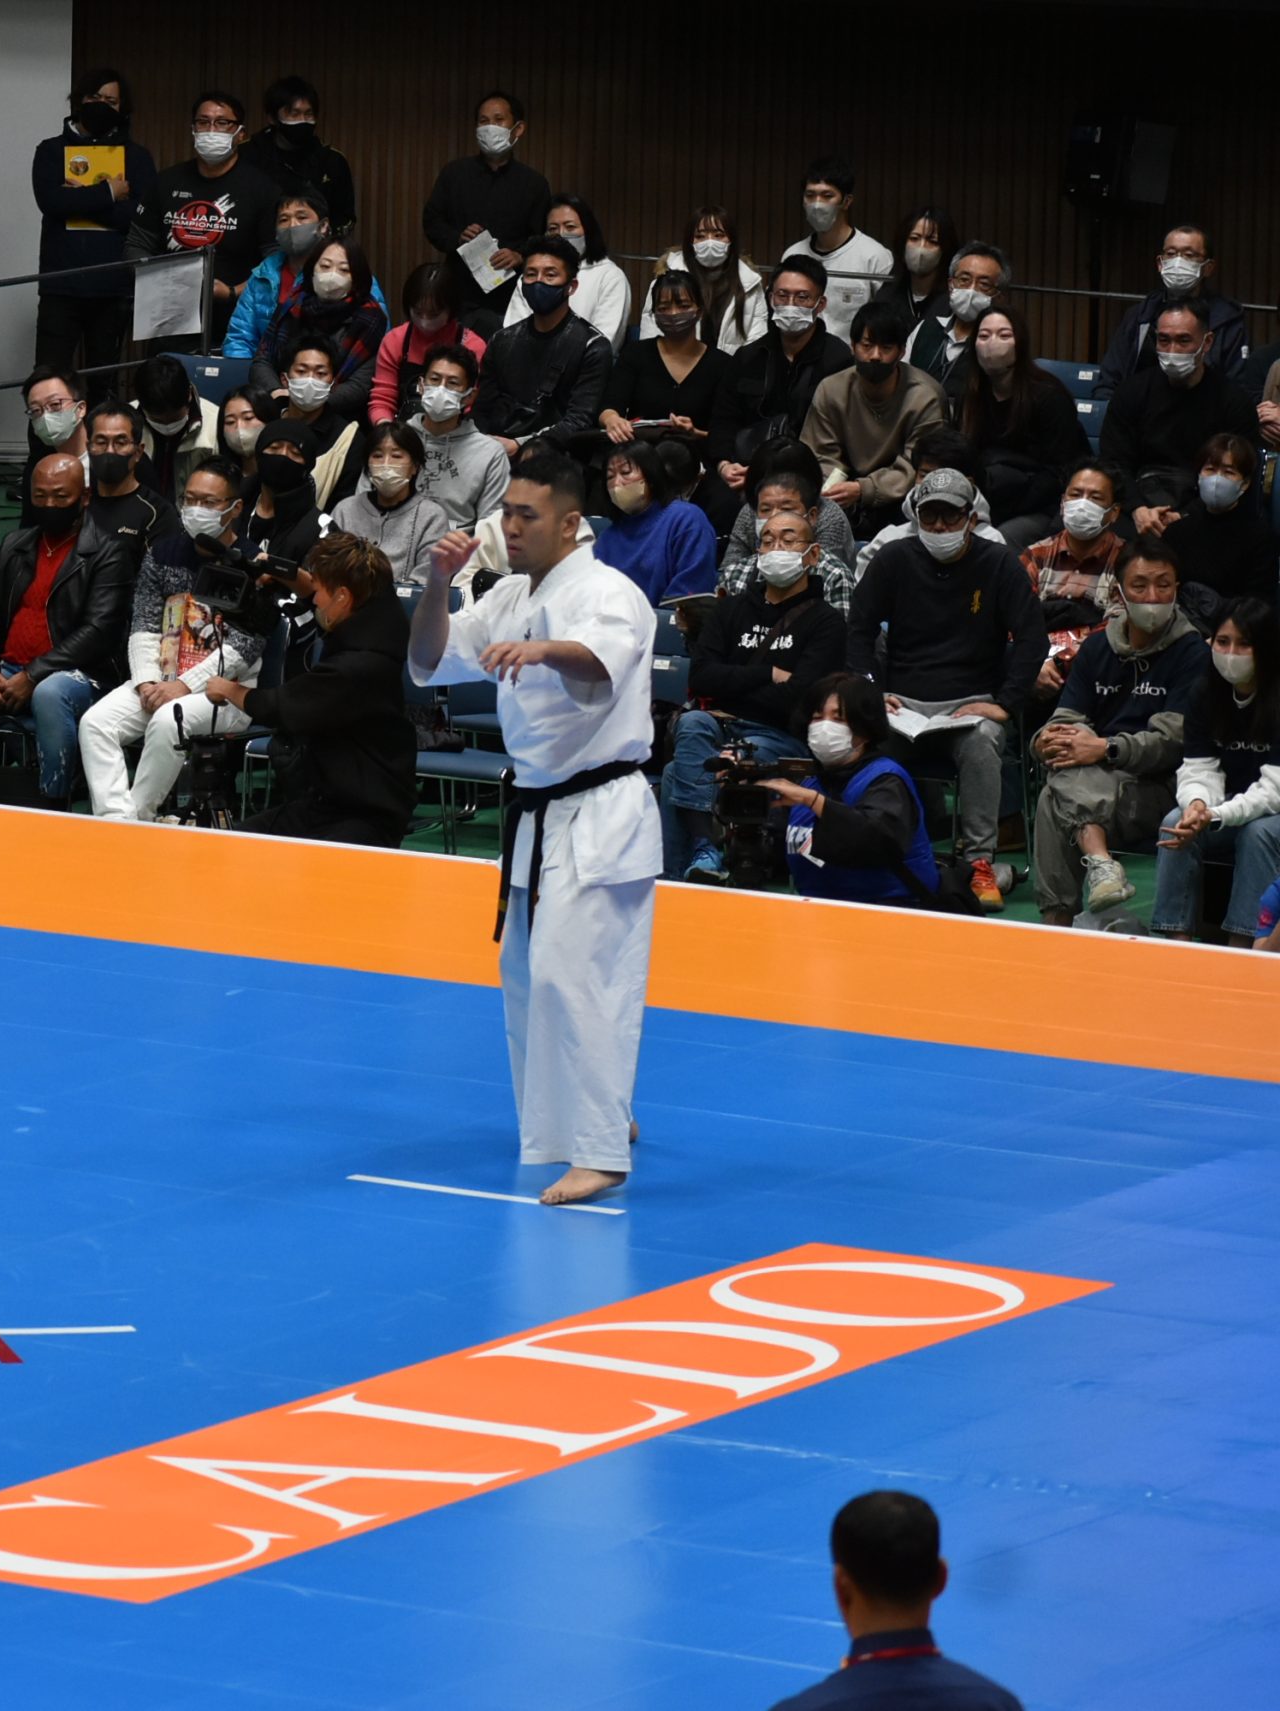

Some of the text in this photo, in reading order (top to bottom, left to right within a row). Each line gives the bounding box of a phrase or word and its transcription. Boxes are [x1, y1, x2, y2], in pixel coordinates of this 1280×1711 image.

[163, 218, 237, 231] CHAMPIONSHIP
[164, 211, 238, 225] ALL JAPAN
